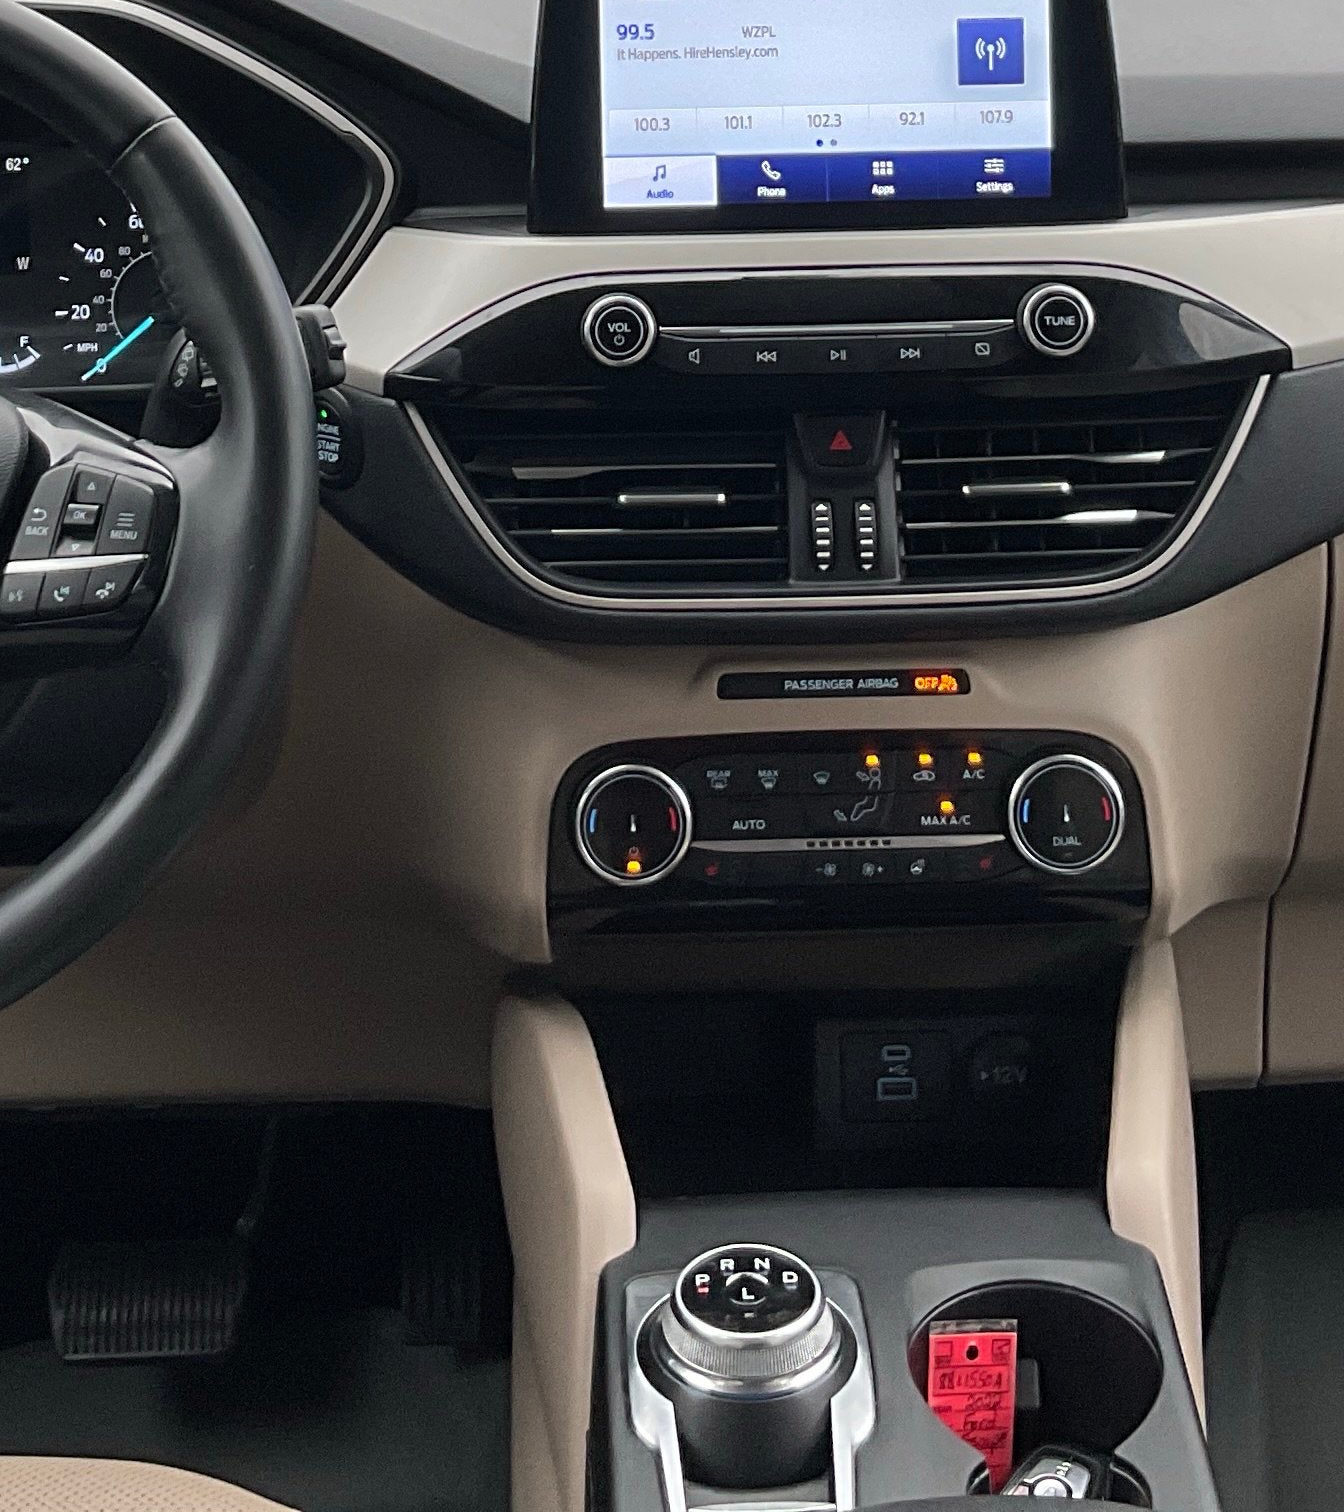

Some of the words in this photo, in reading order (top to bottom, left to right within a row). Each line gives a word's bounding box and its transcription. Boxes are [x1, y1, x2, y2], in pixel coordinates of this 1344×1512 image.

[616, 24, 655, 41] 99.5
[741, 25, 777, 38] WZPL
[616, 47, 626, 61] It
[628, 46, 681, 64] Happens.
[683, 43, 779, 63] HireHensley.com
[633, 116, 671, 133] 100.3
[723, 114, 754, 131] 101.1
[806, 112, 843, 130] 102.3
[898, 110, 926, 127] 92.1
[978, 109, 1014, 126] 107.9
[5, 156, 31, 172] 62°
[646, 188, 674, 200] Audio
[757, 185, 787, 198] Phone
[871, 183, 896, 198] Apps
[976, 180, 1015, 195] Settings
[84, 247, 105, 264] 40
[118, 246, 131, 256] 80
[16, 256, 31, 271] W
[99, 268, 113, 279] 60
[92, 295, 105, 305] 40
[71, 304, 91, 321] 20
[1044, 315, 1076, 327] TUNE
[96, 323, 108, 333] 20
[606, 322, 632, 335] VOL
[19, 336, 30, 348] F
[77, 343, 99, 352] MPH
[317, 450, 339, 463] STOP
[72, 509, 88, 521] OK
[24, 526, 49, 537] BACK
[109, 530, 138, 541] MENU
[784, 678, 854, 692] PASSENGER
[857, 677, 899, 690] AIRBAG
[914, 676, 939, 691] OFF
[706, 769, 732, 779] REAR
[757, 769, 779, 779] MAX
[962, 768, 986, 781] A/C
[731, 819, 766, 831] AUTO
[920, 814, 947, 827] MAX
[948, 814, 972, 827] A/C
[1052, 835, 1082, 848] DUAL
[720, 1258, 735, 1272] R
[754, 1257, 771, 1271] N
[695, 1273, 710, 1288] P
[783, 1271, 799, 1285] D
[741, 1287, 755, 1301] L
